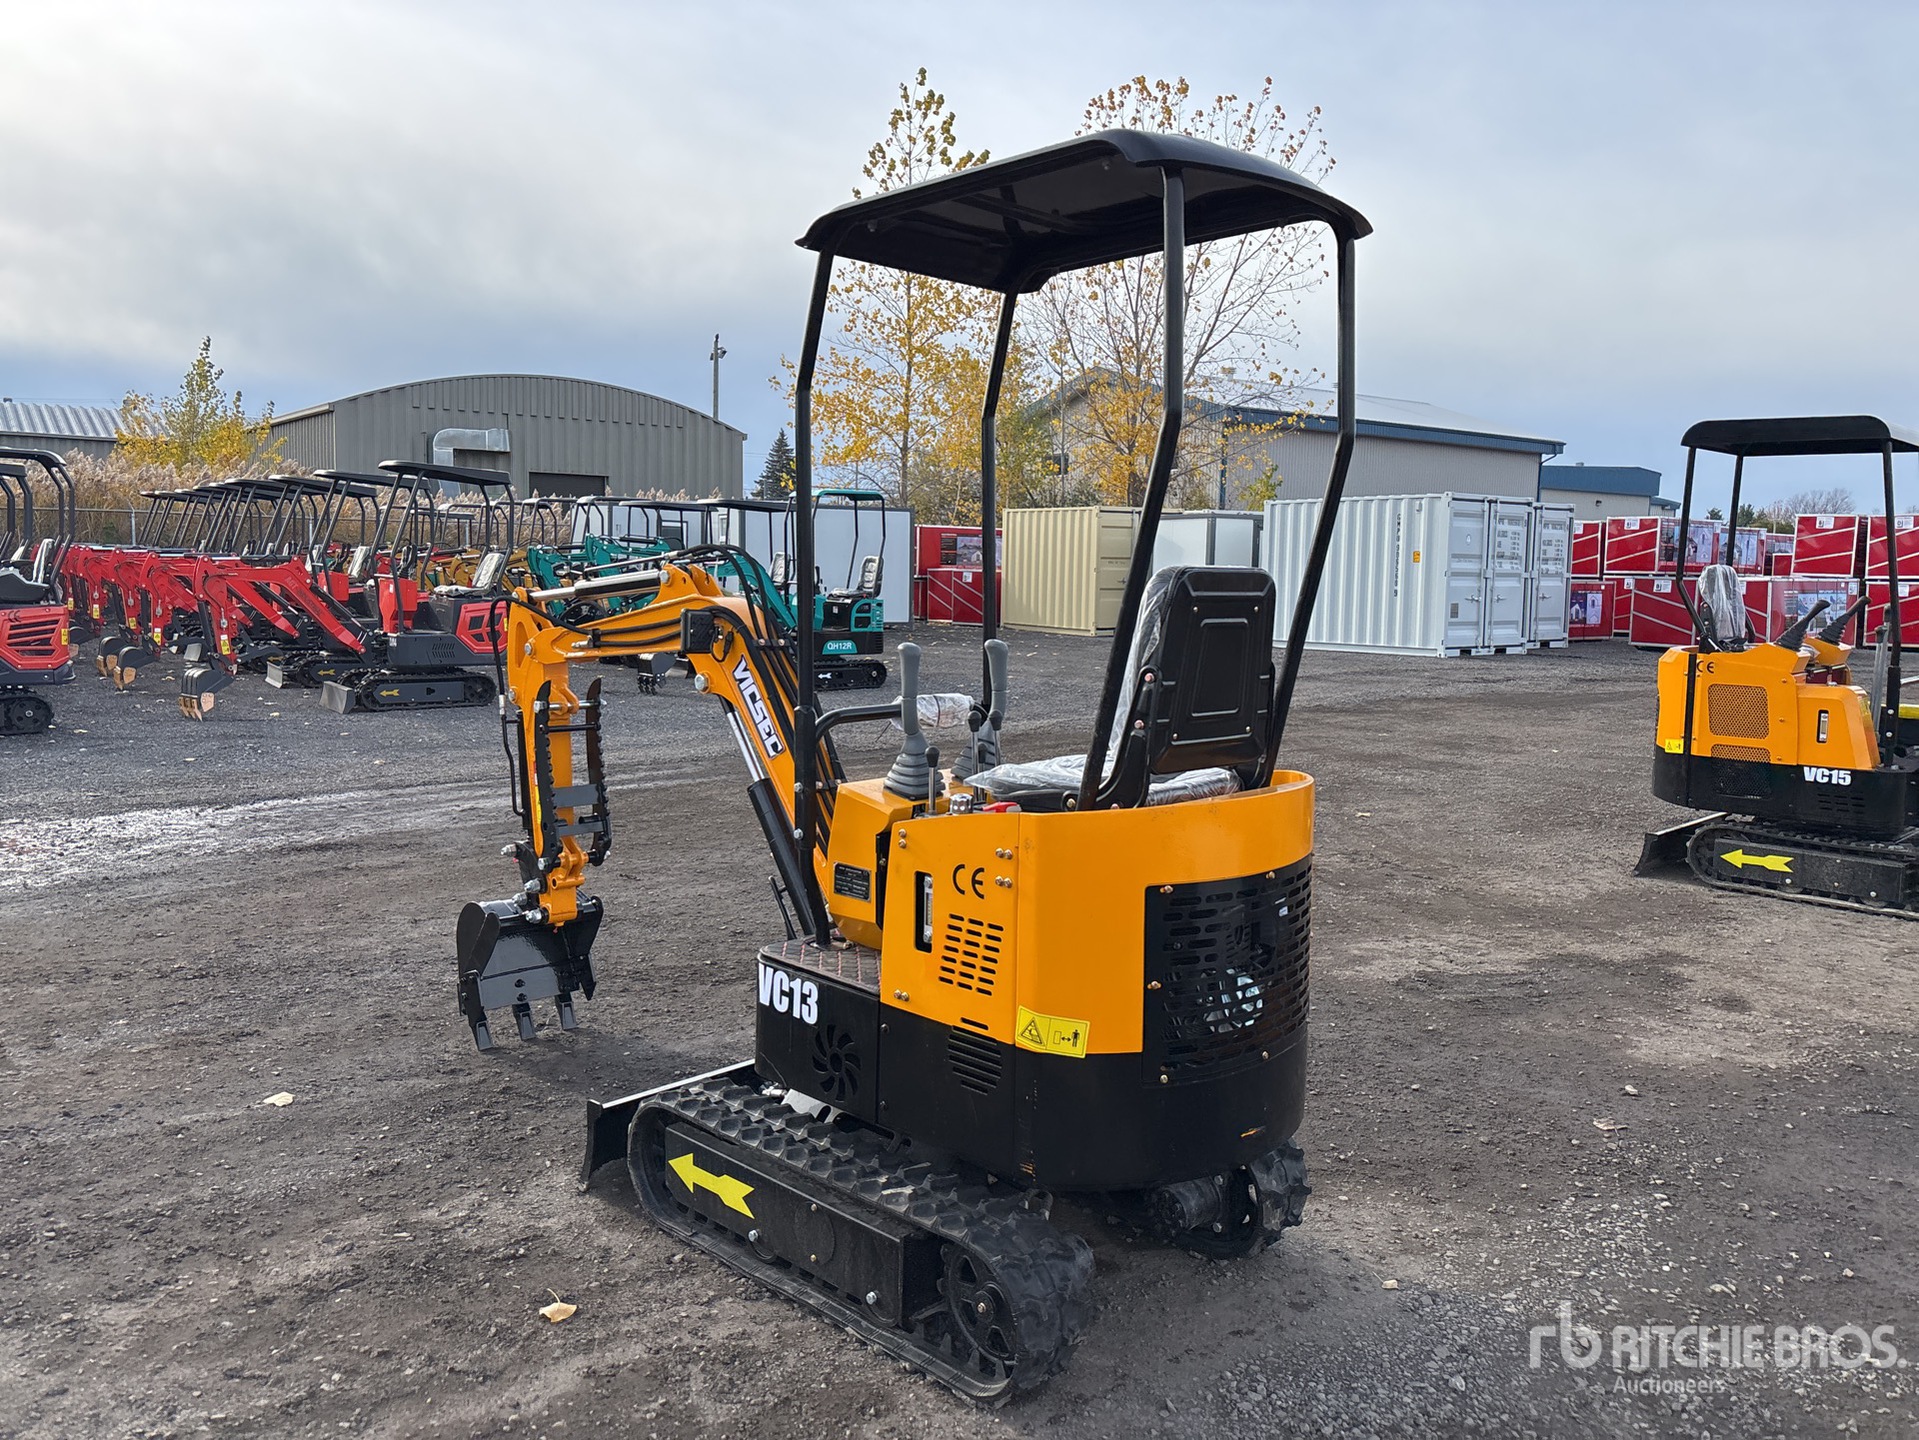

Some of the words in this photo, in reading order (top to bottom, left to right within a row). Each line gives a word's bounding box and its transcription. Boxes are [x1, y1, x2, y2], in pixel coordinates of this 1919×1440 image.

[733, 655, 785, 759] VICSEC
[1803, 766, 1852, 786] VC15
[758, 962, 819, 1025] VC13
